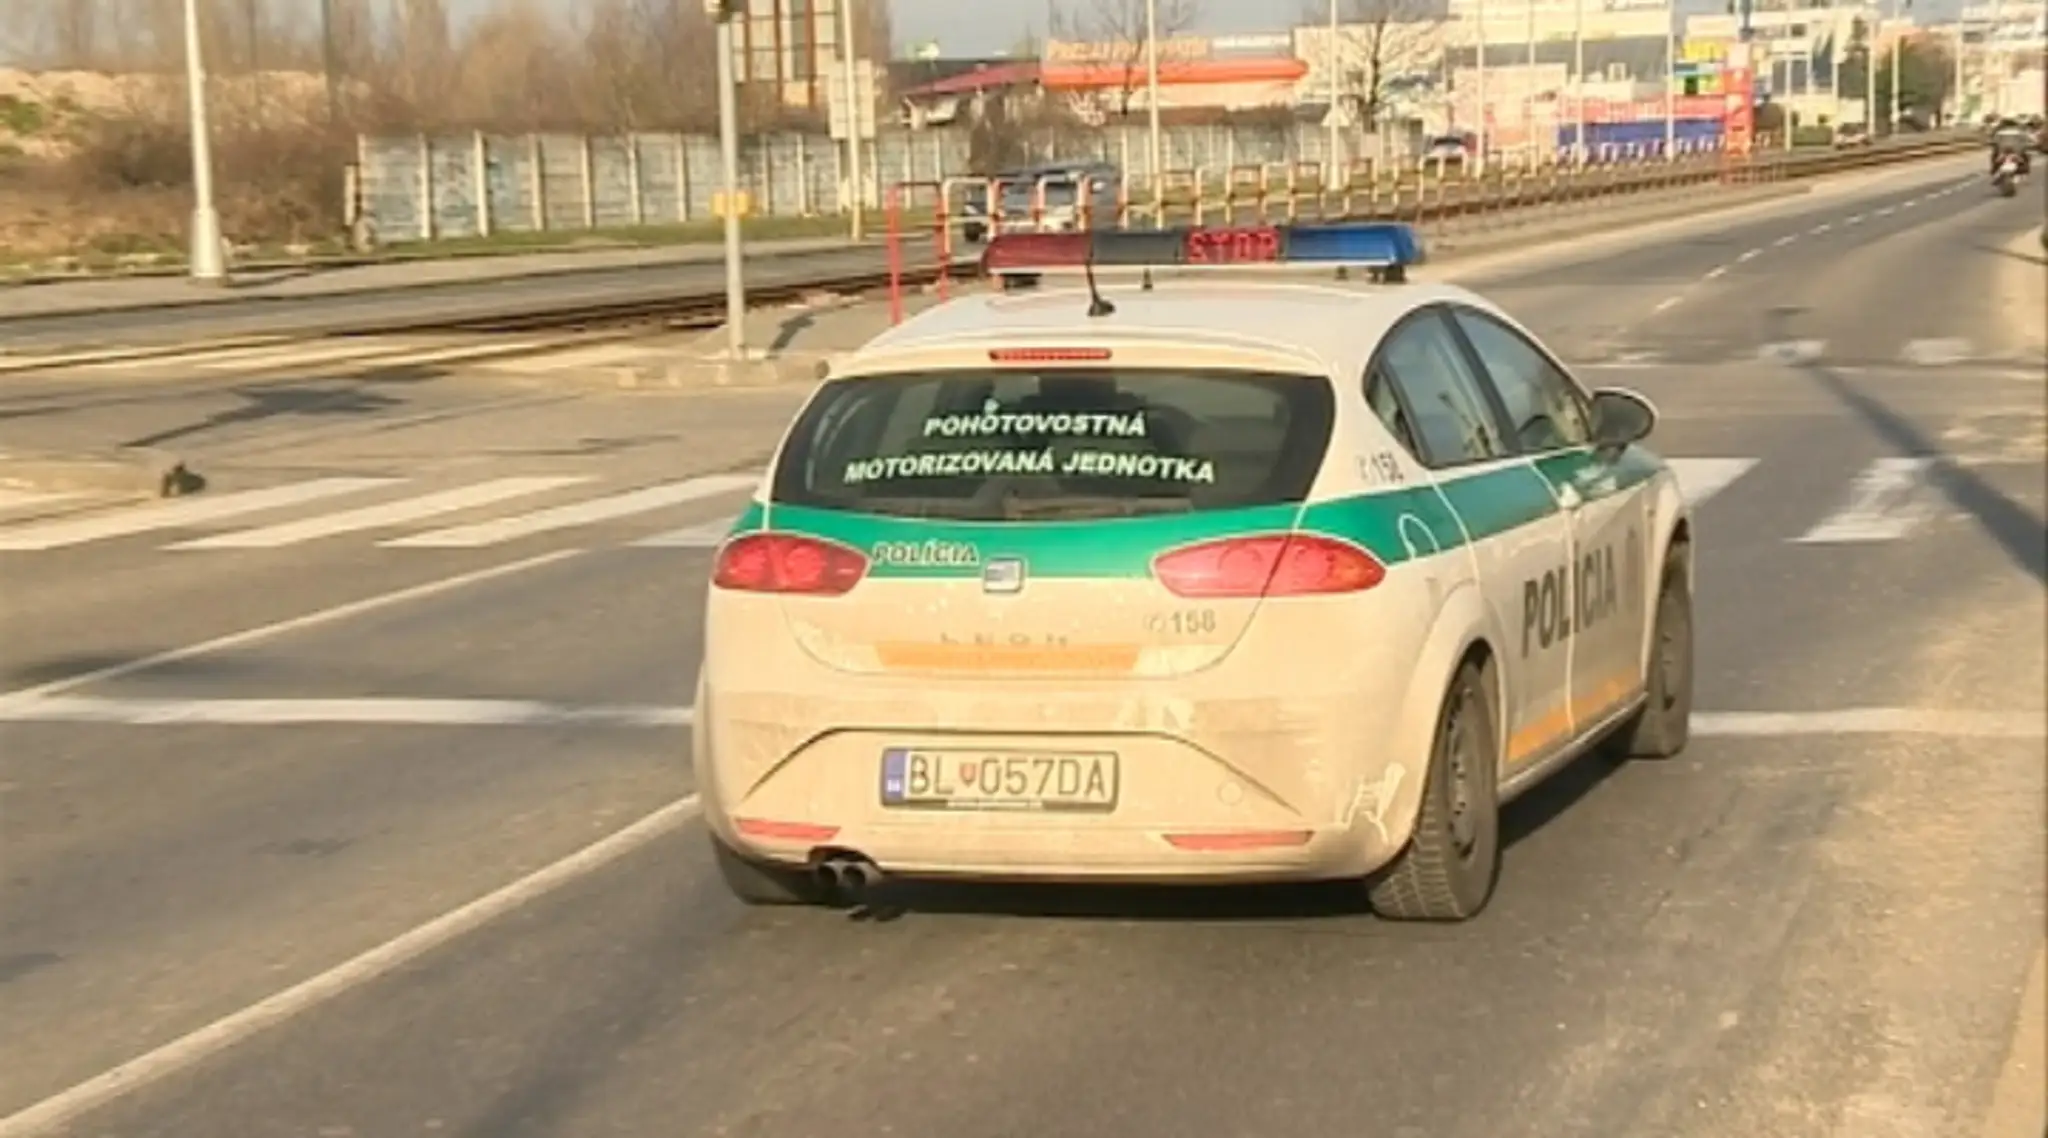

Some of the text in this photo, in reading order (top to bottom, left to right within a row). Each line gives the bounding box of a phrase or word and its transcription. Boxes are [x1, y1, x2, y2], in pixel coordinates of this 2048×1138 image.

[1188, 231, 1277, 263] STOP
[843, 447, 1216, 484] MOTORIZOVANÁ JEDNOTKA
[1168, 609, 1217, 634] 158
